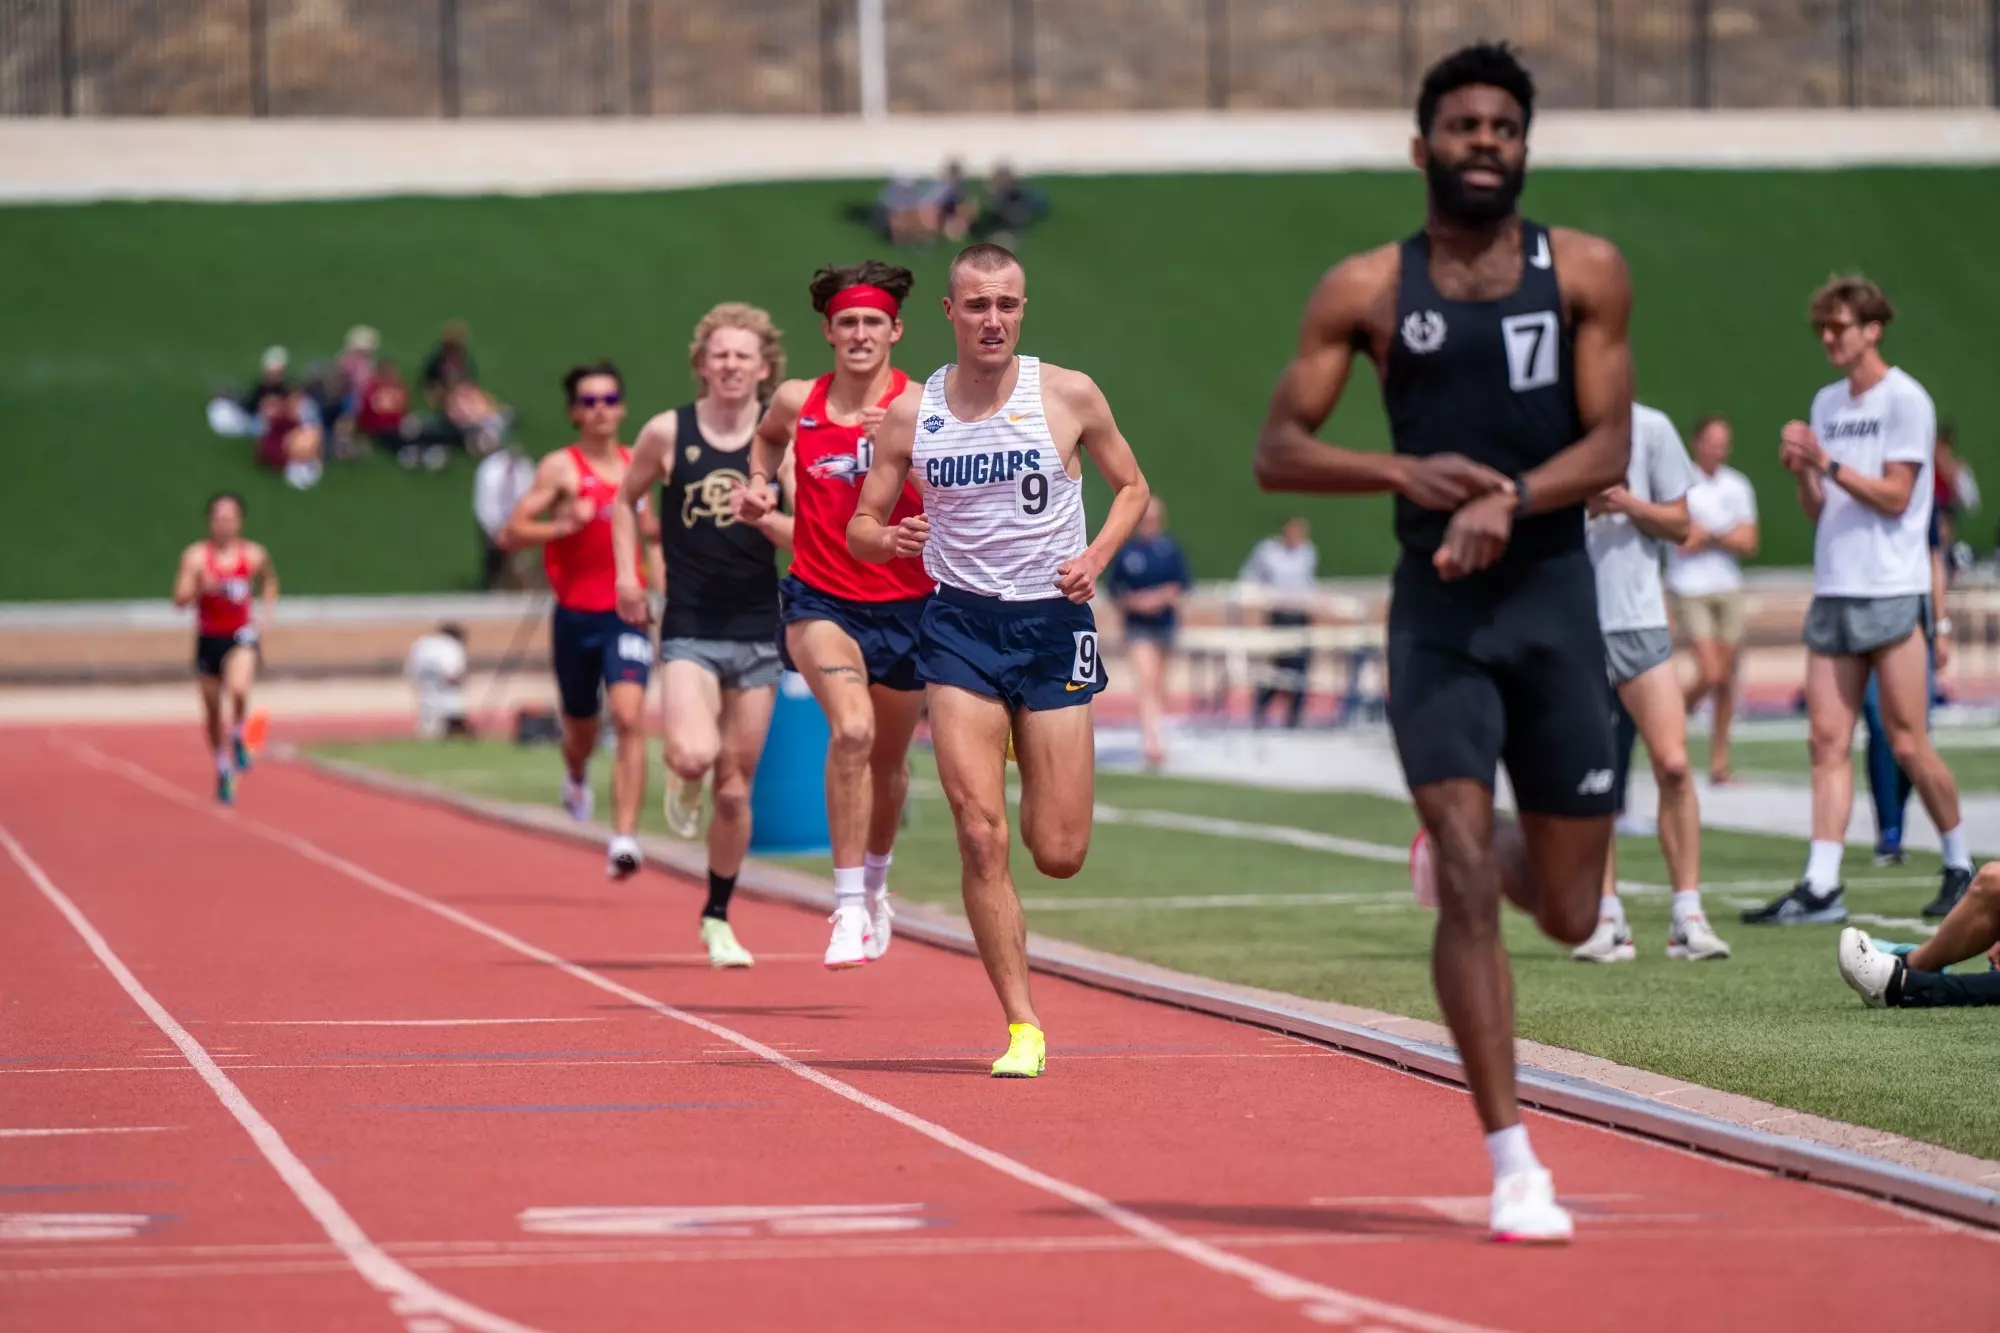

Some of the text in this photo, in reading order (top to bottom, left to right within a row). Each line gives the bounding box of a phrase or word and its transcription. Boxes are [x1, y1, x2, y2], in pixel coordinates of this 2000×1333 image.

[1513, 323, 1546, 380] 7
[926, 449, 1041, 488] COUGARS
[1021, 472, 1049, 515] 9
[1079, 634, 1095, 679] 9
